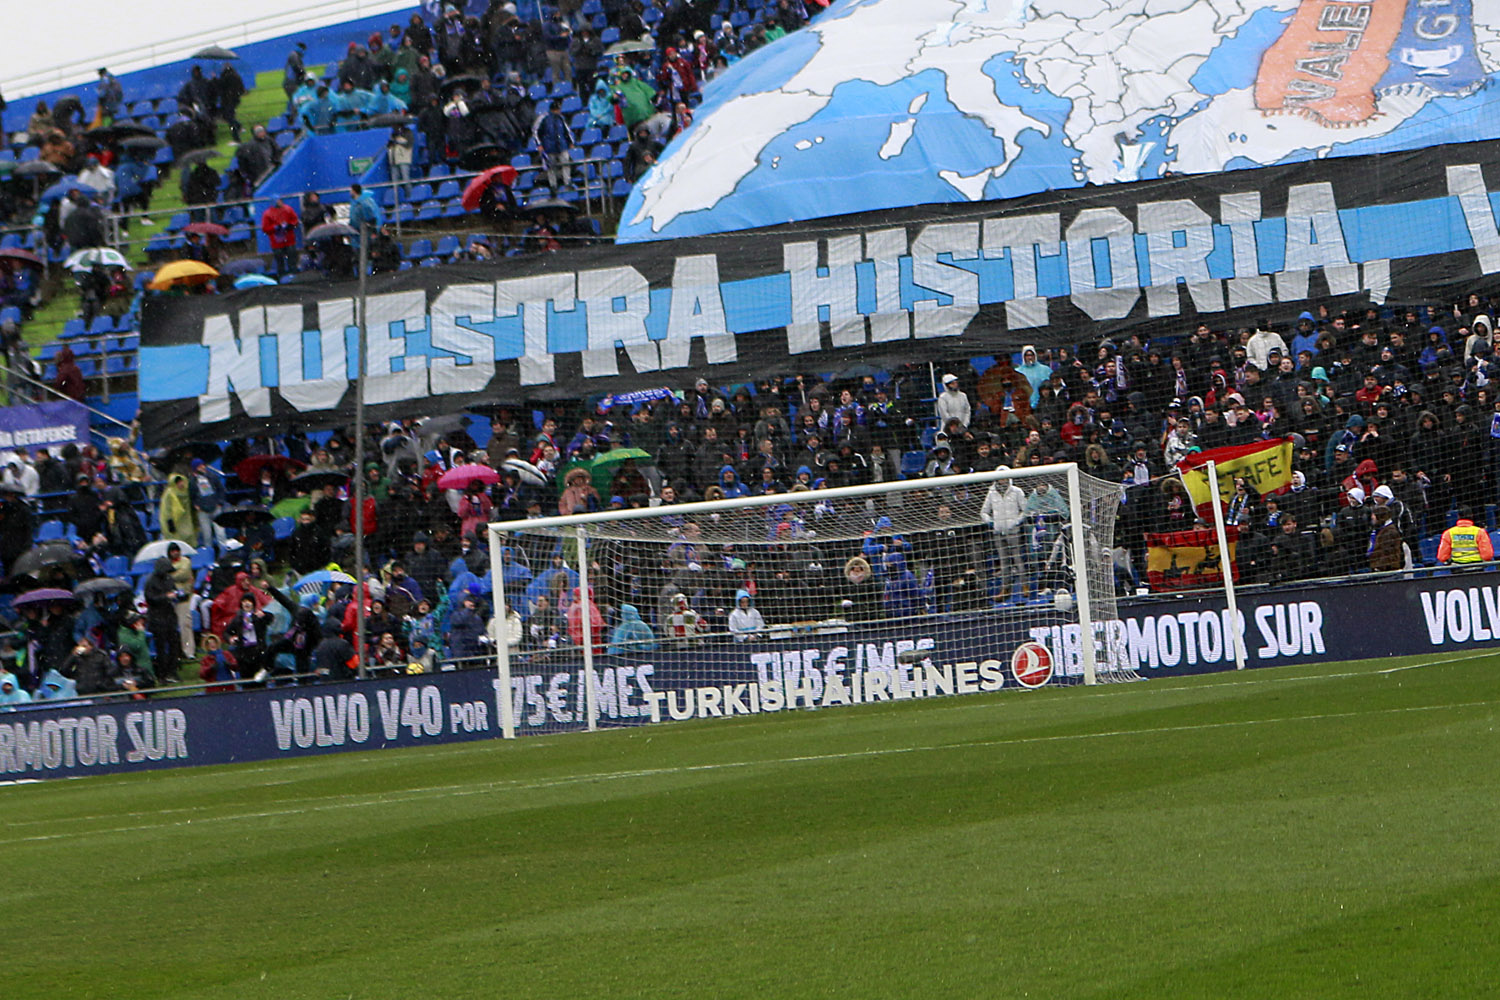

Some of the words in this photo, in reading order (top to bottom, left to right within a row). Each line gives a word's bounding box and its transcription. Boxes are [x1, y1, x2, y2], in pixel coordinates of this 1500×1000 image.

[200, 254, 738, 424] NUESTRA
[783, 182, 1391, 355] HISTORIA,
[1255, 601, 1326, 659] SUR
[270, 693, 369, 751] VOLVO
[377, 685, 443, 740] V40
[450, 701, 489, 734] POR
[643, 677, 816, 723] TURKISH
[822, 660, 1005, 706] AIRLINES
[125, 708, 189, 763] SUR
